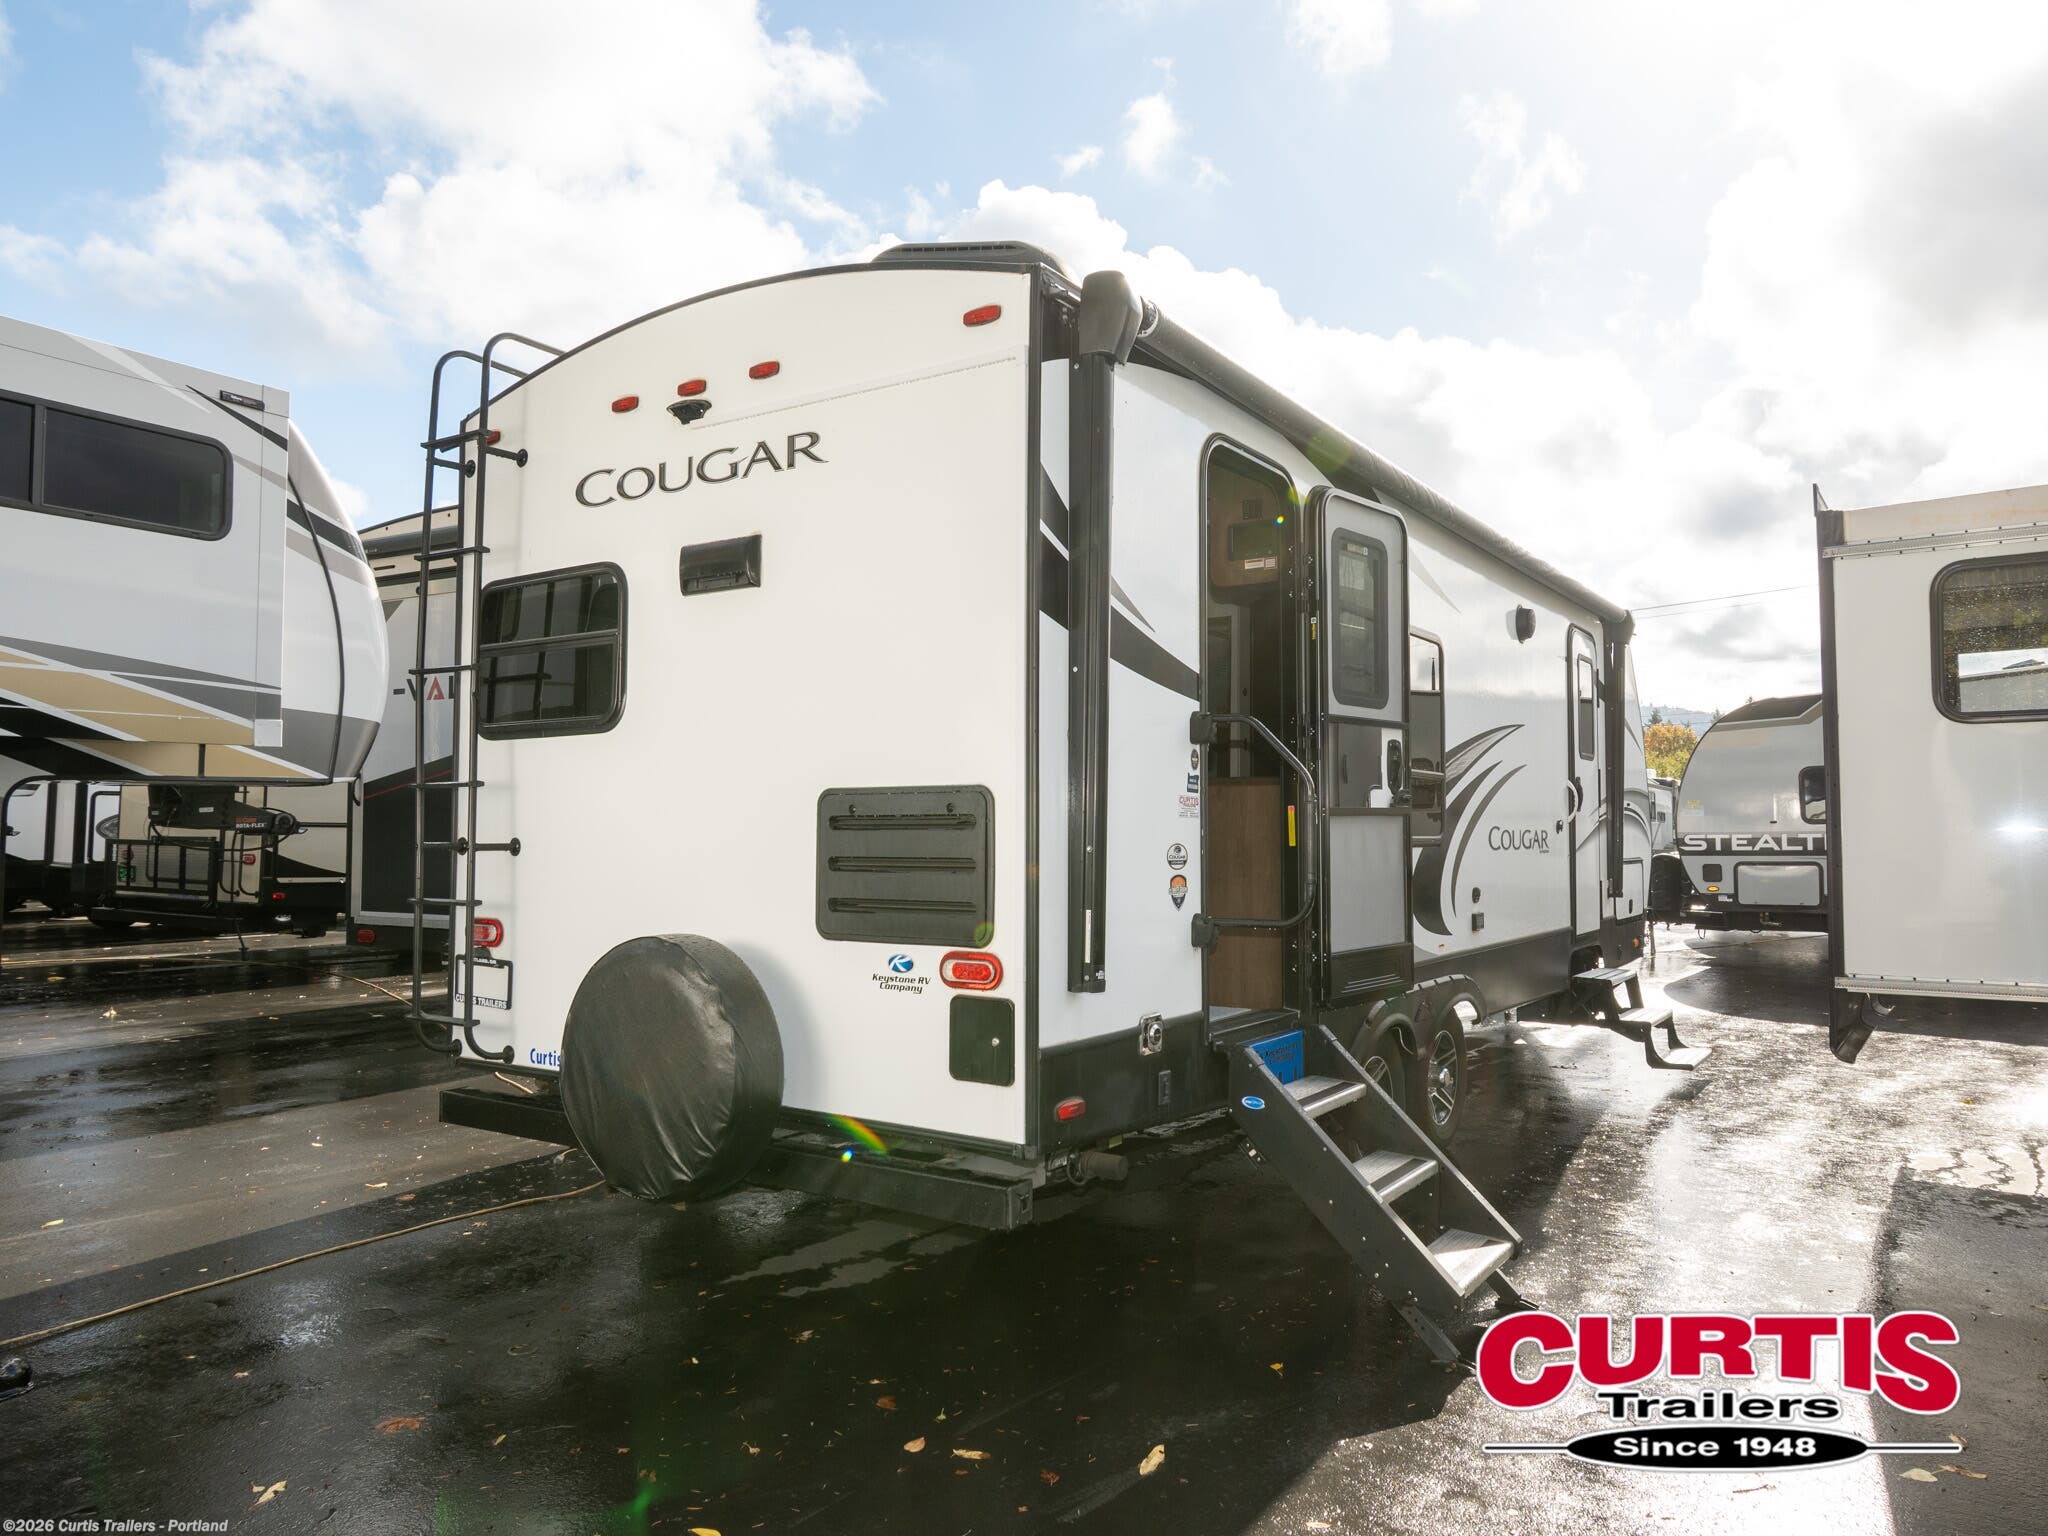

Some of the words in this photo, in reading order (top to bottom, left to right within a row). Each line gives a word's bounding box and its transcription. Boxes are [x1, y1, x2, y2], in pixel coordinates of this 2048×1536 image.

[575, 431, 829, 507] COUGAR
[1488, 825, 1549, 851] COUGAR
[872, 973, 916, 984] Keystone
[917, 976, 931, 985] RV
[879, 982, 923, 994] Company
[455, 994, 476, 1006] CUS
[478, 997, 507, 1009] TRAILERS
